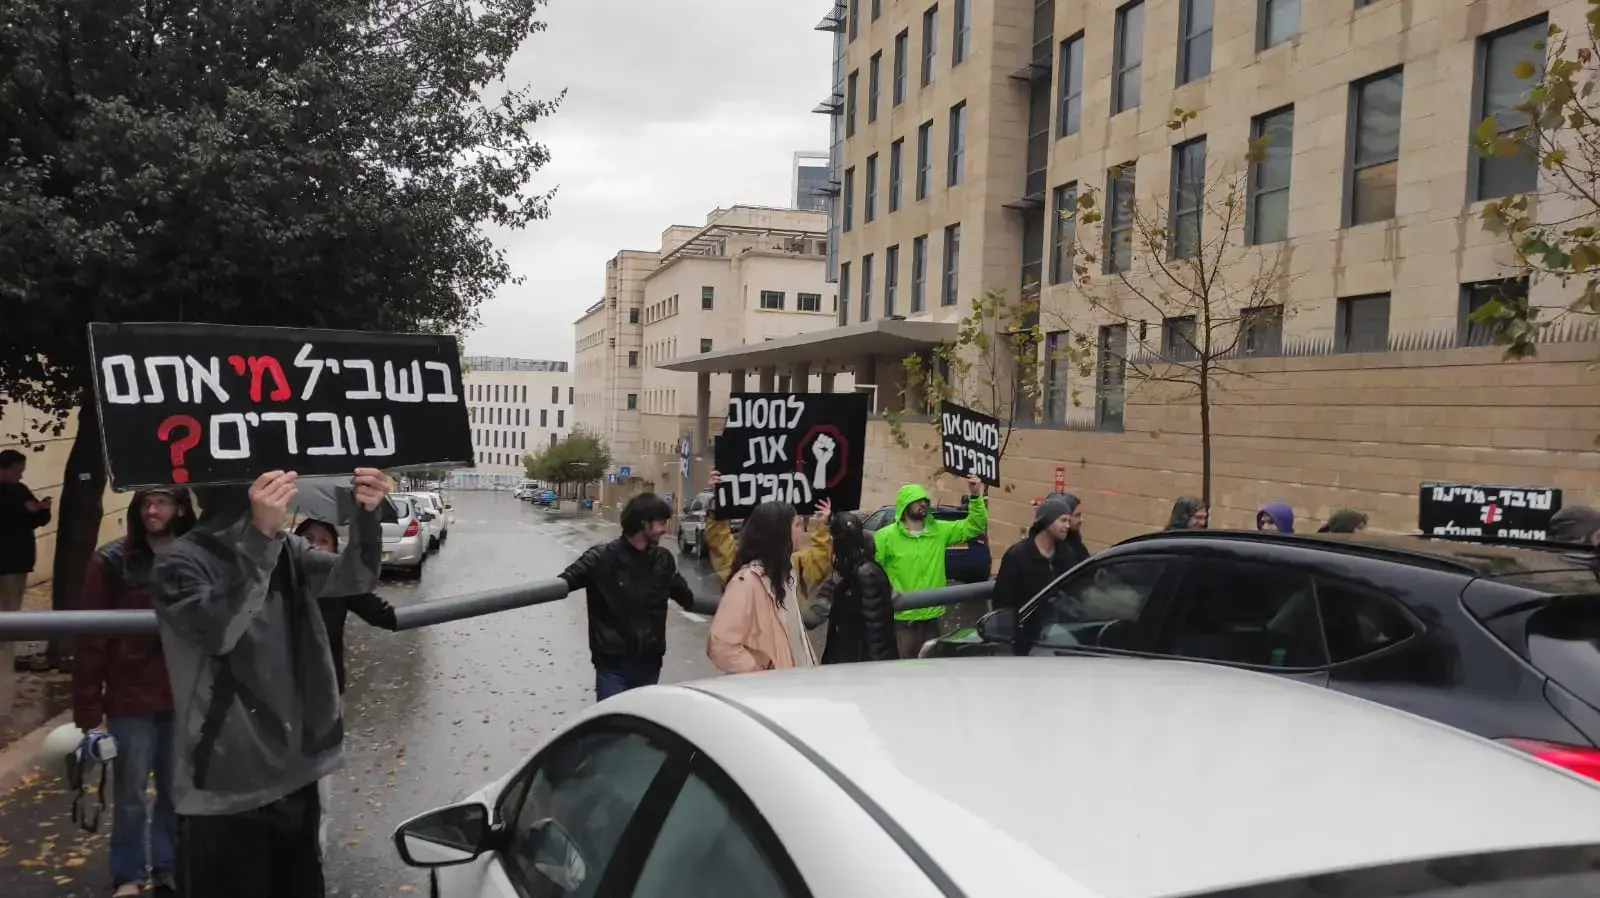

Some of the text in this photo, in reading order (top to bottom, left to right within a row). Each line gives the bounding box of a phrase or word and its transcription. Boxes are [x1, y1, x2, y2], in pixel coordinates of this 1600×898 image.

[101, 343, 459, 405] בשביל מי אתם
[725, 394, 805, 429] לחסום
[942, 413, 999, 450] לחסום את
[742, 434, 788, 468] את
[718, 471, 812, 507] ההפיכה
